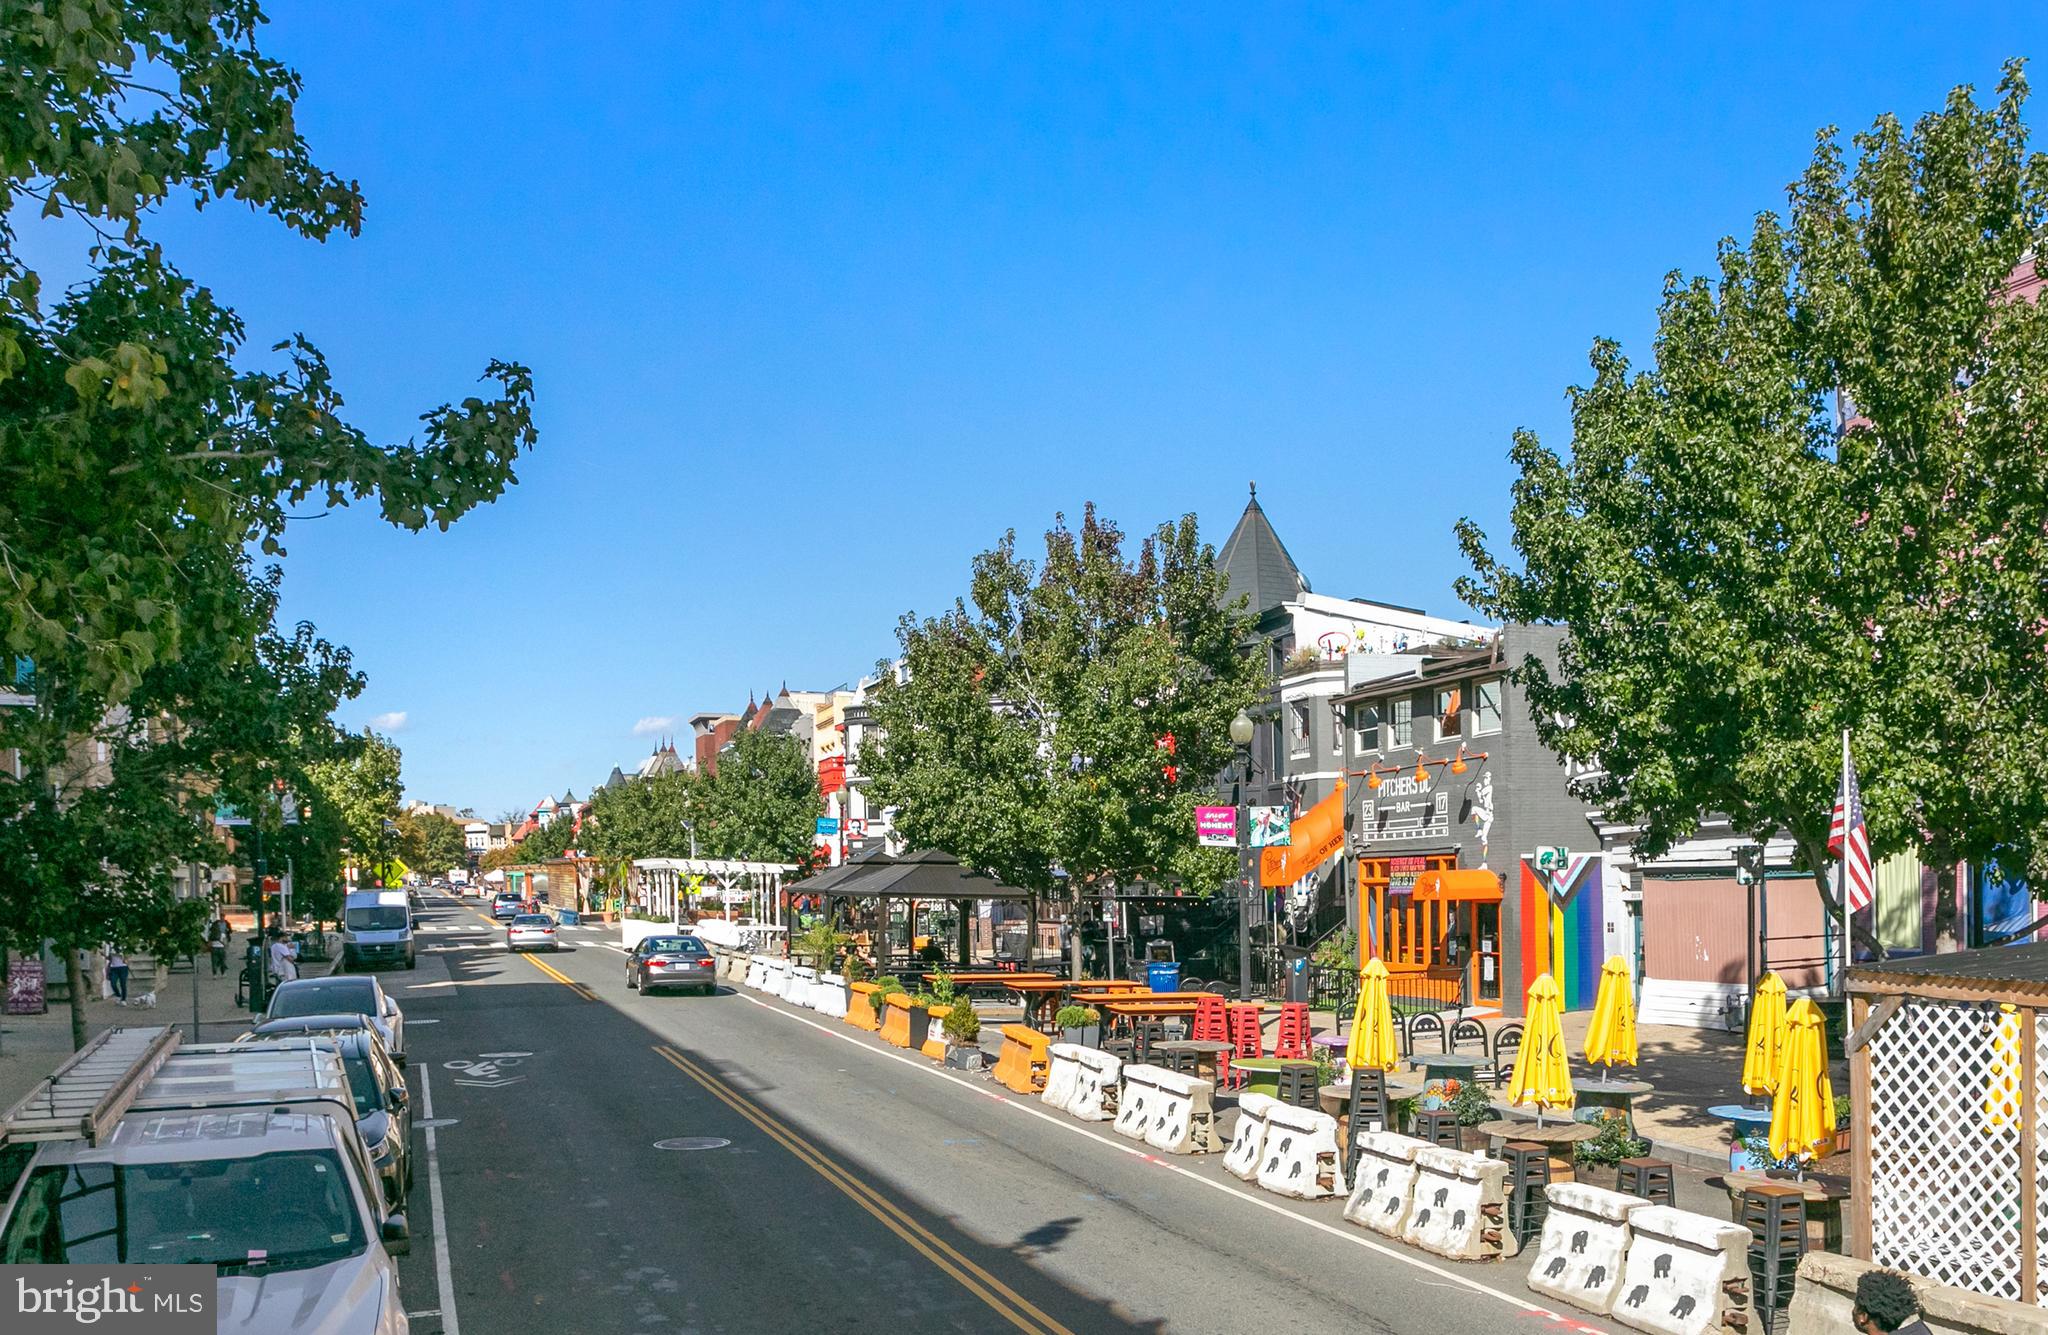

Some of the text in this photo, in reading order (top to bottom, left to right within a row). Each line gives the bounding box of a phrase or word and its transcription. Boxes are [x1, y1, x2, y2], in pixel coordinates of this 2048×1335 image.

[1378, 775, 1418, 798] PITCHERS
[1395, 801, 1411, 813] BAR
[1200, 822, 1233, 830] MOMENT
[1319, 835, 1344, 855] OF HER
